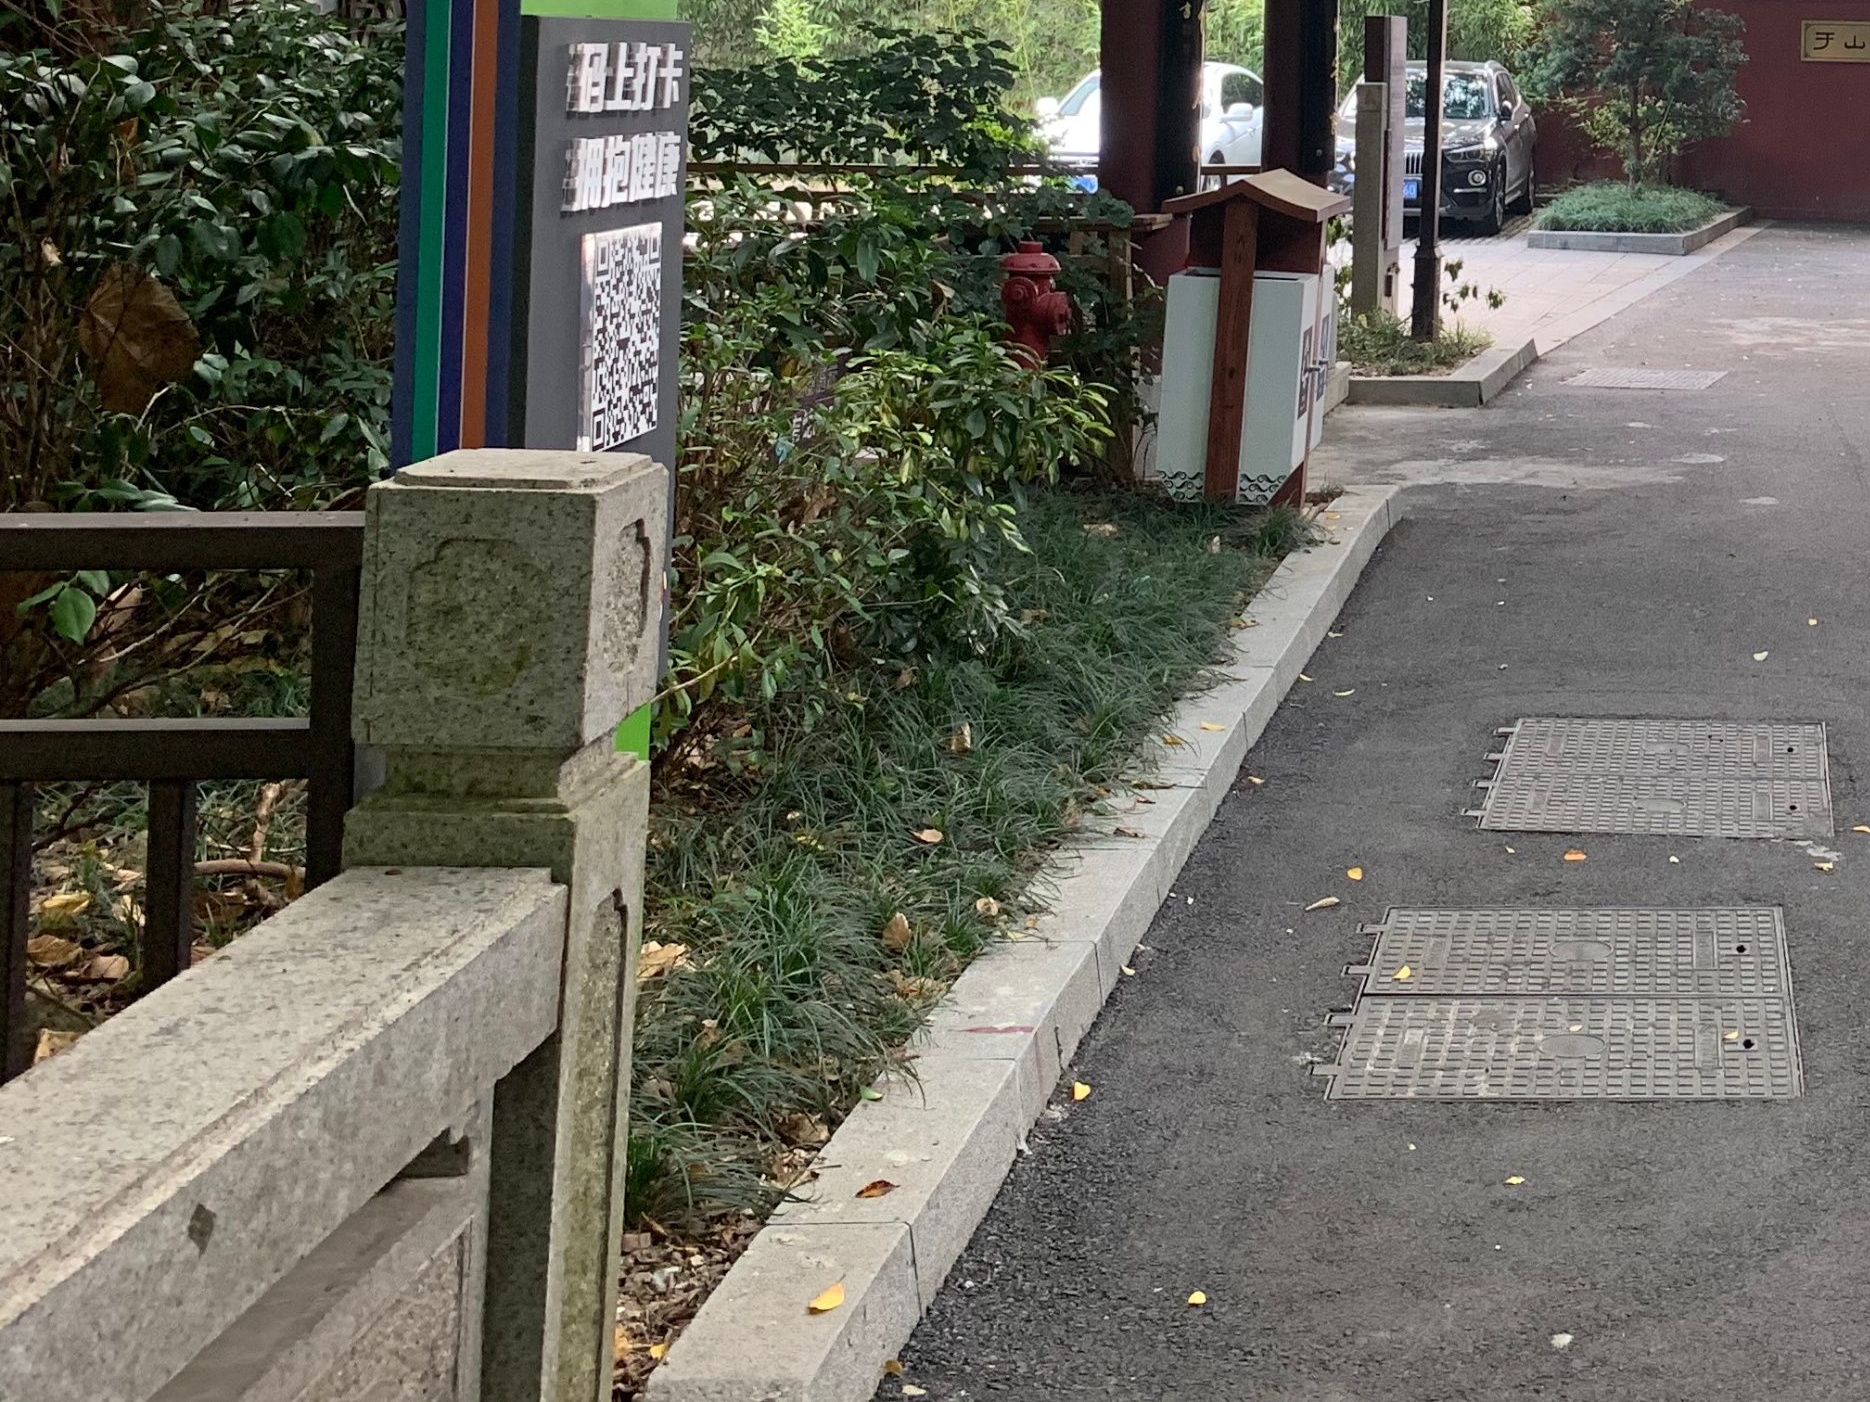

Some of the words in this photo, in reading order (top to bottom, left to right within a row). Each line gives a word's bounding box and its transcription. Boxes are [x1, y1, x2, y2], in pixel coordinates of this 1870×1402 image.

[570, 42, 683, 113] 码上打卡
[565, 131, 681, 211] 拥抱健康
